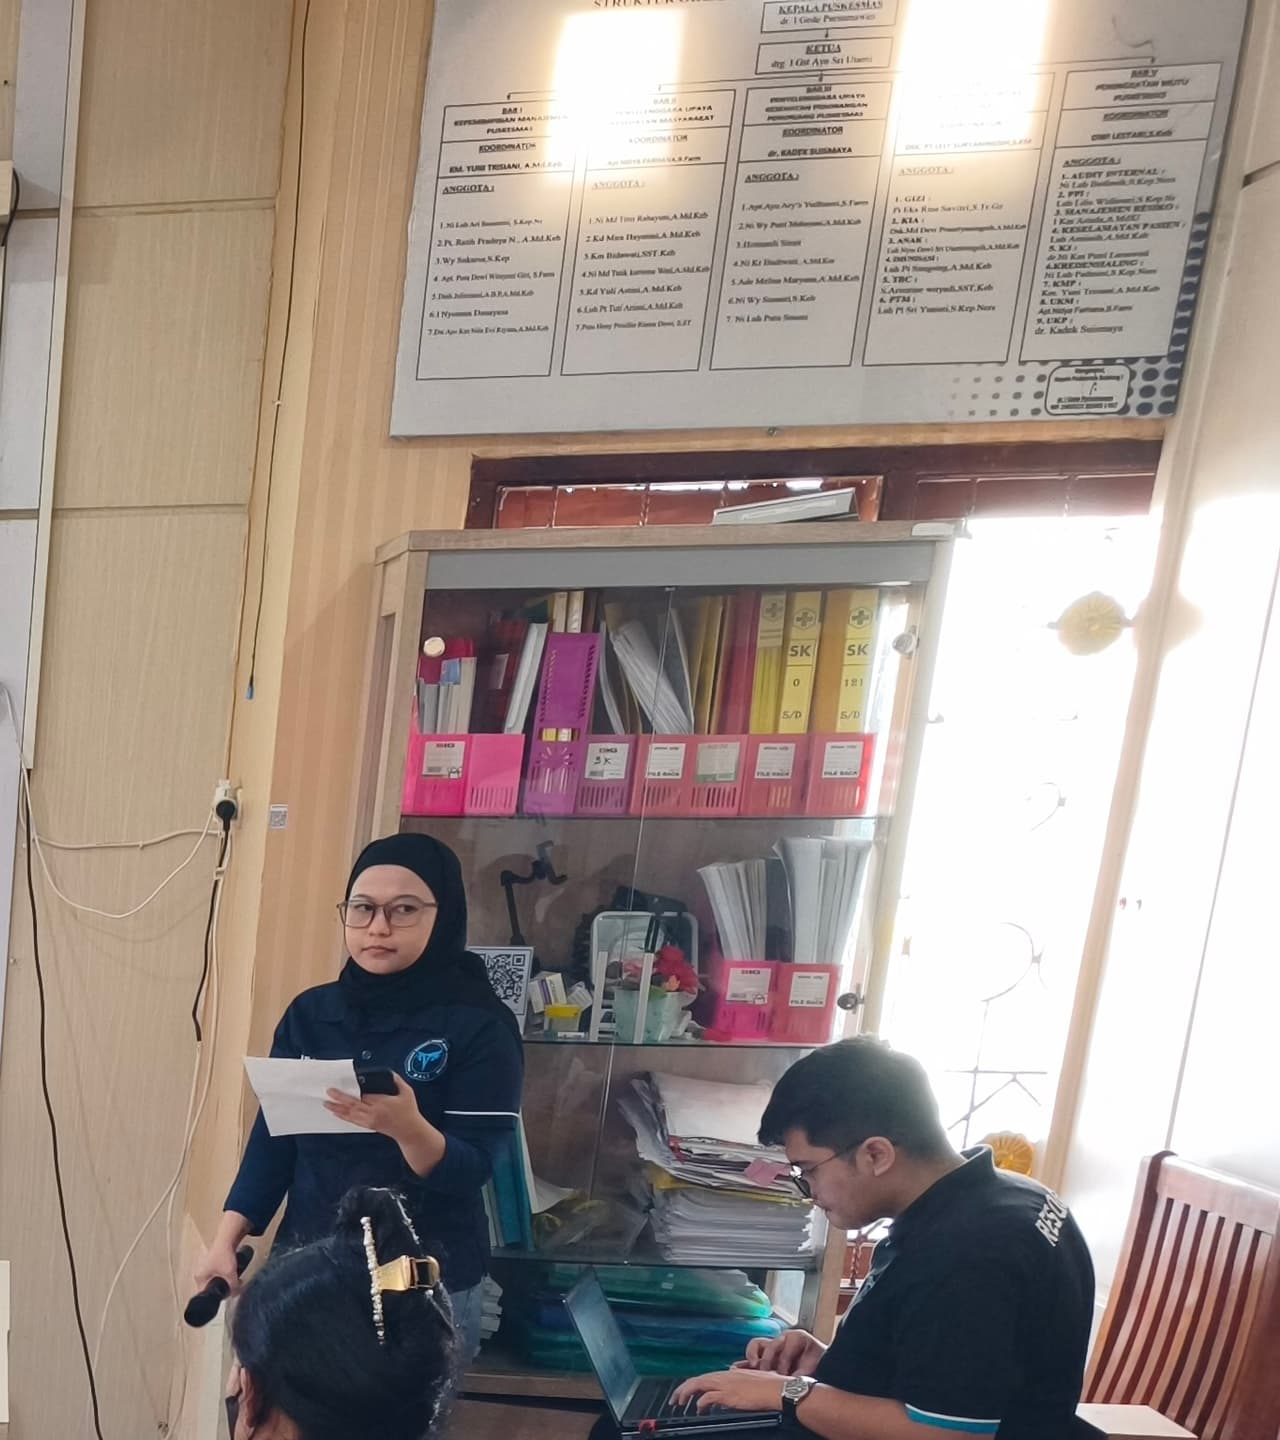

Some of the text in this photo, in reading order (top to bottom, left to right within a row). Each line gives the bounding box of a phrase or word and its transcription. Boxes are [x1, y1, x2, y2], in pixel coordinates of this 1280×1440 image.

[805, 43, 842, 55] KETUA
[789, 644, 812, 657] SK
[846, 643, 869, 657] SK
